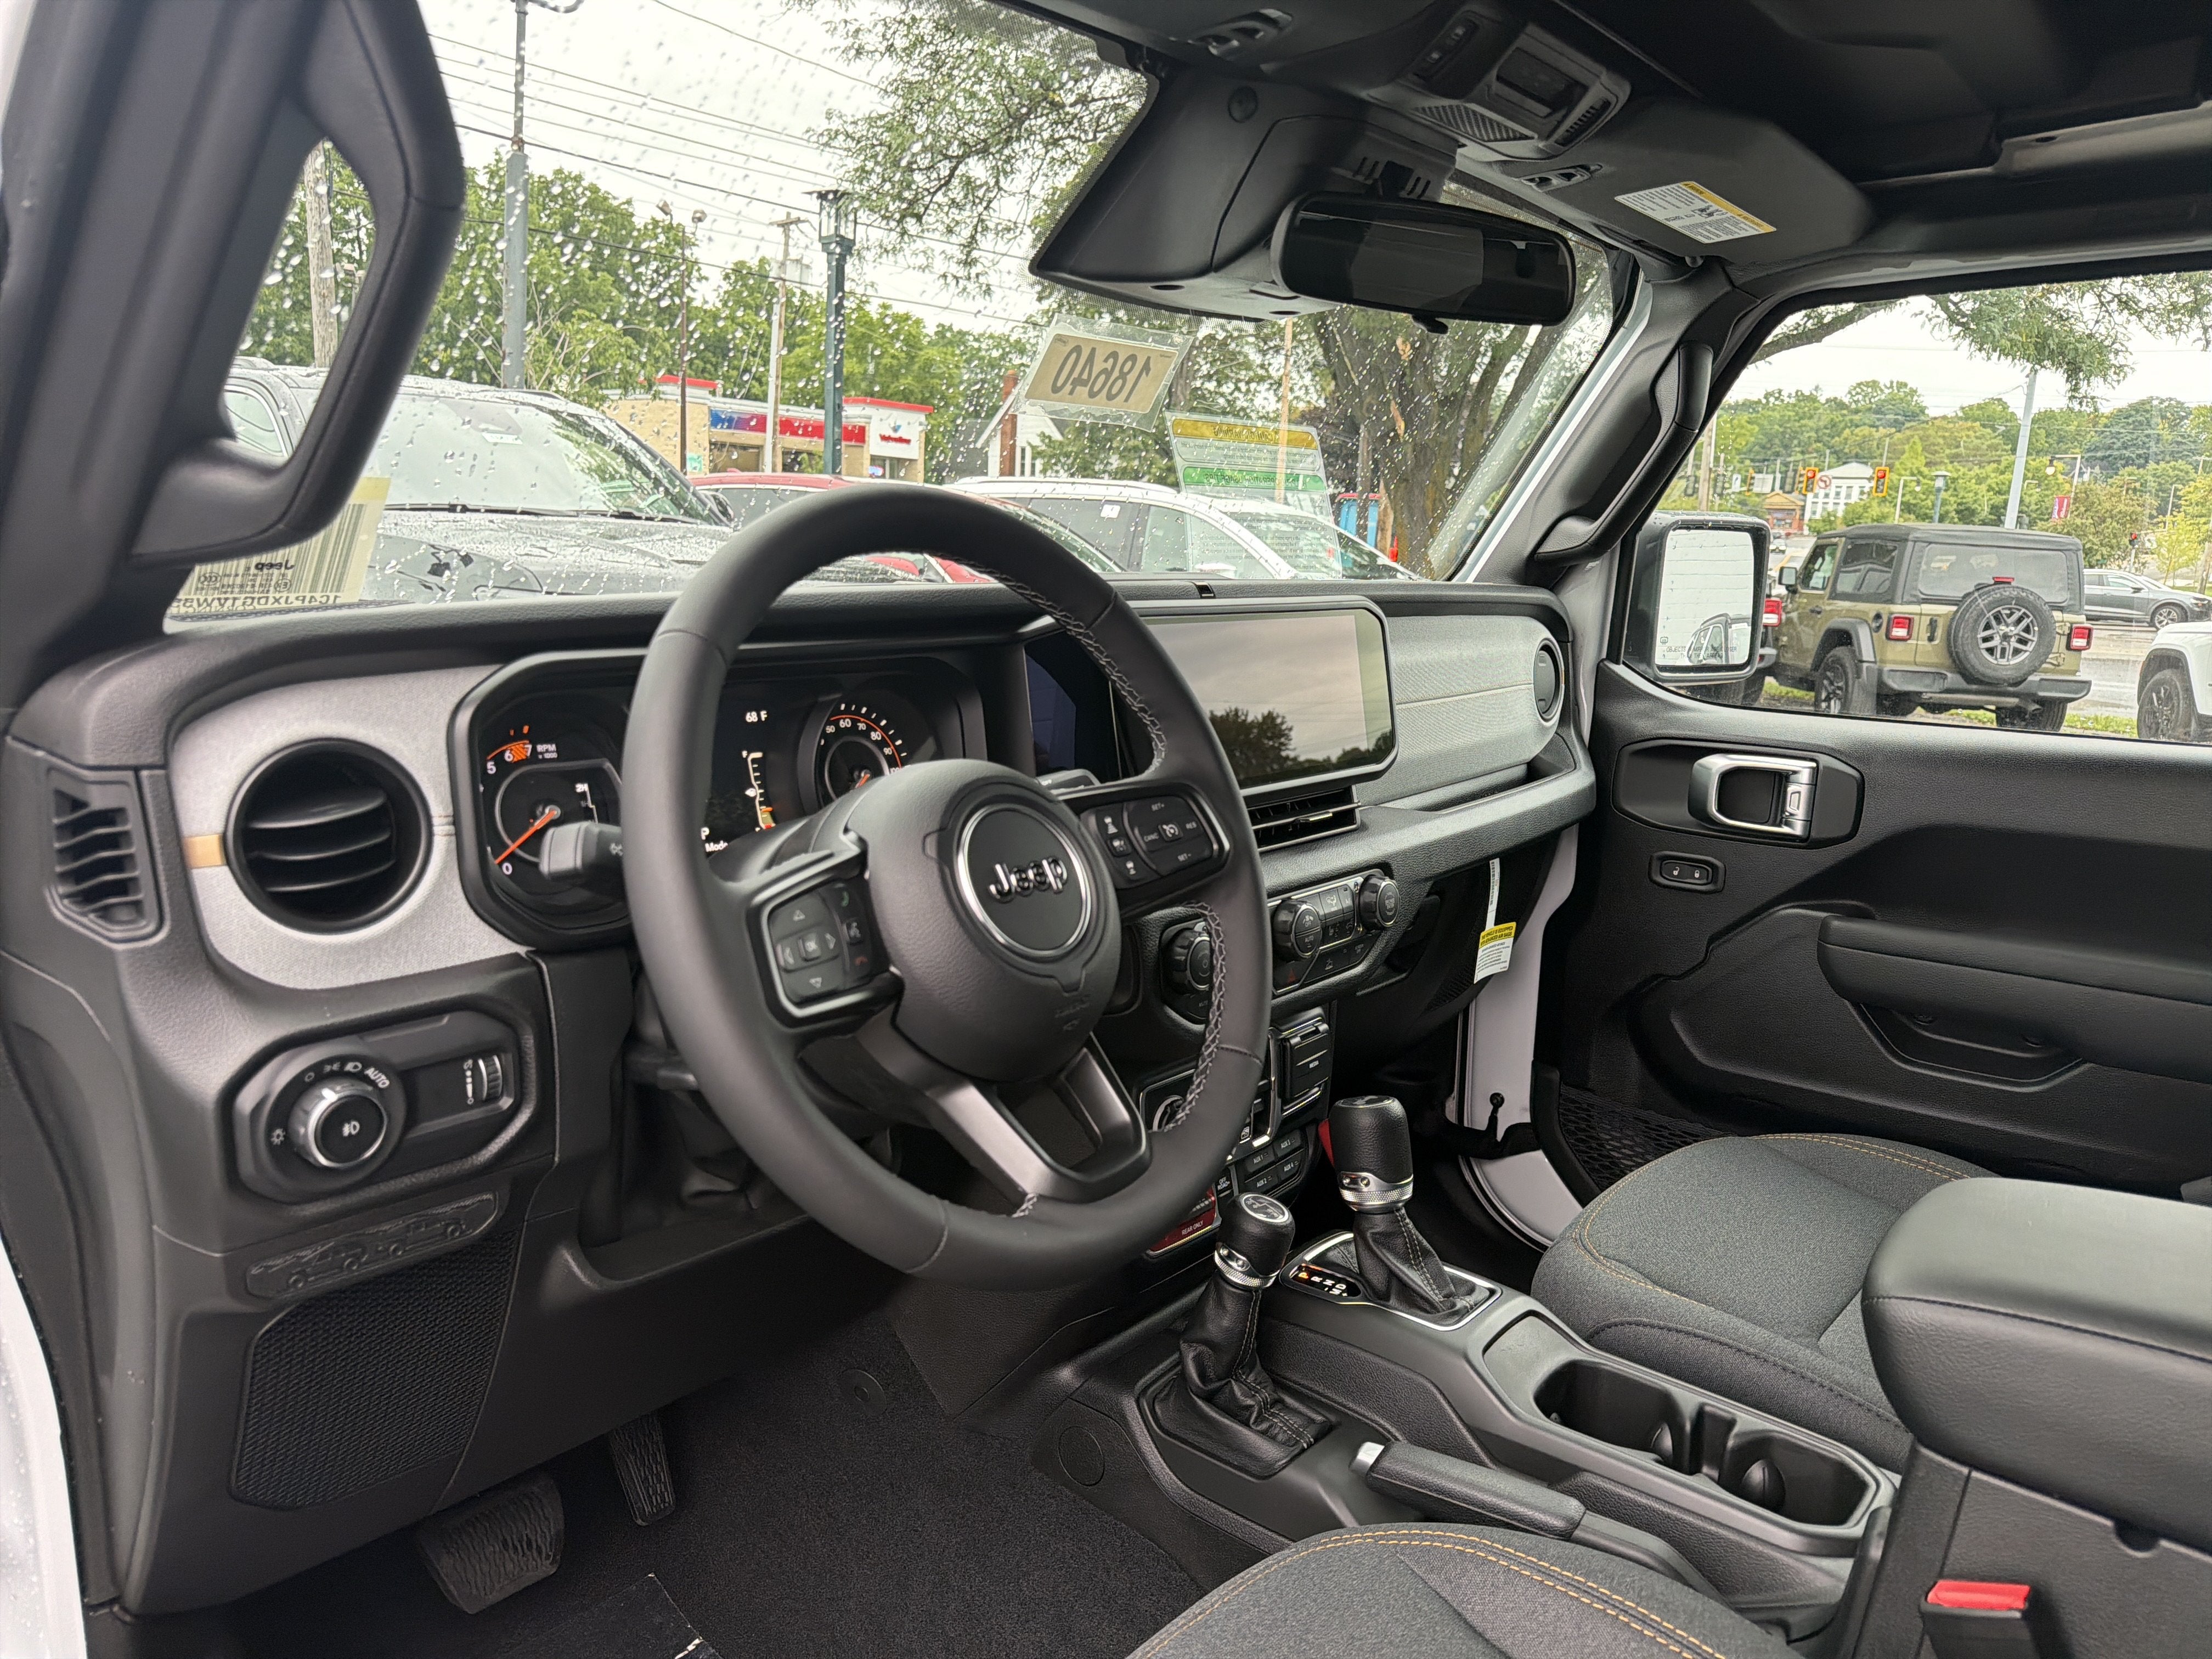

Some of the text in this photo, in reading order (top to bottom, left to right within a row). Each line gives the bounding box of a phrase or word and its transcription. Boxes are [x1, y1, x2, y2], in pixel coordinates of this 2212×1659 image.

[746, 710, 768, 724] 68 F
[825, 724, 836, 733] 50
[839, 718, 851, 729] 60
[856, 722, 867, 731] 70
[870, 731, 882, 741] 80
[536, 743, 557, 753] RPM
[883, 747, 893, 756] 90
[504, 750, 513, 761] 6
[487, 761, 496, 774] 5
[988, 857, 1068, 902] Jeep
[364, 1067, 390, 1088] AUTO
[1181, 1220, 1204, 1235] REAR ONLY
[1298, 1272, 1309, 1280] P
